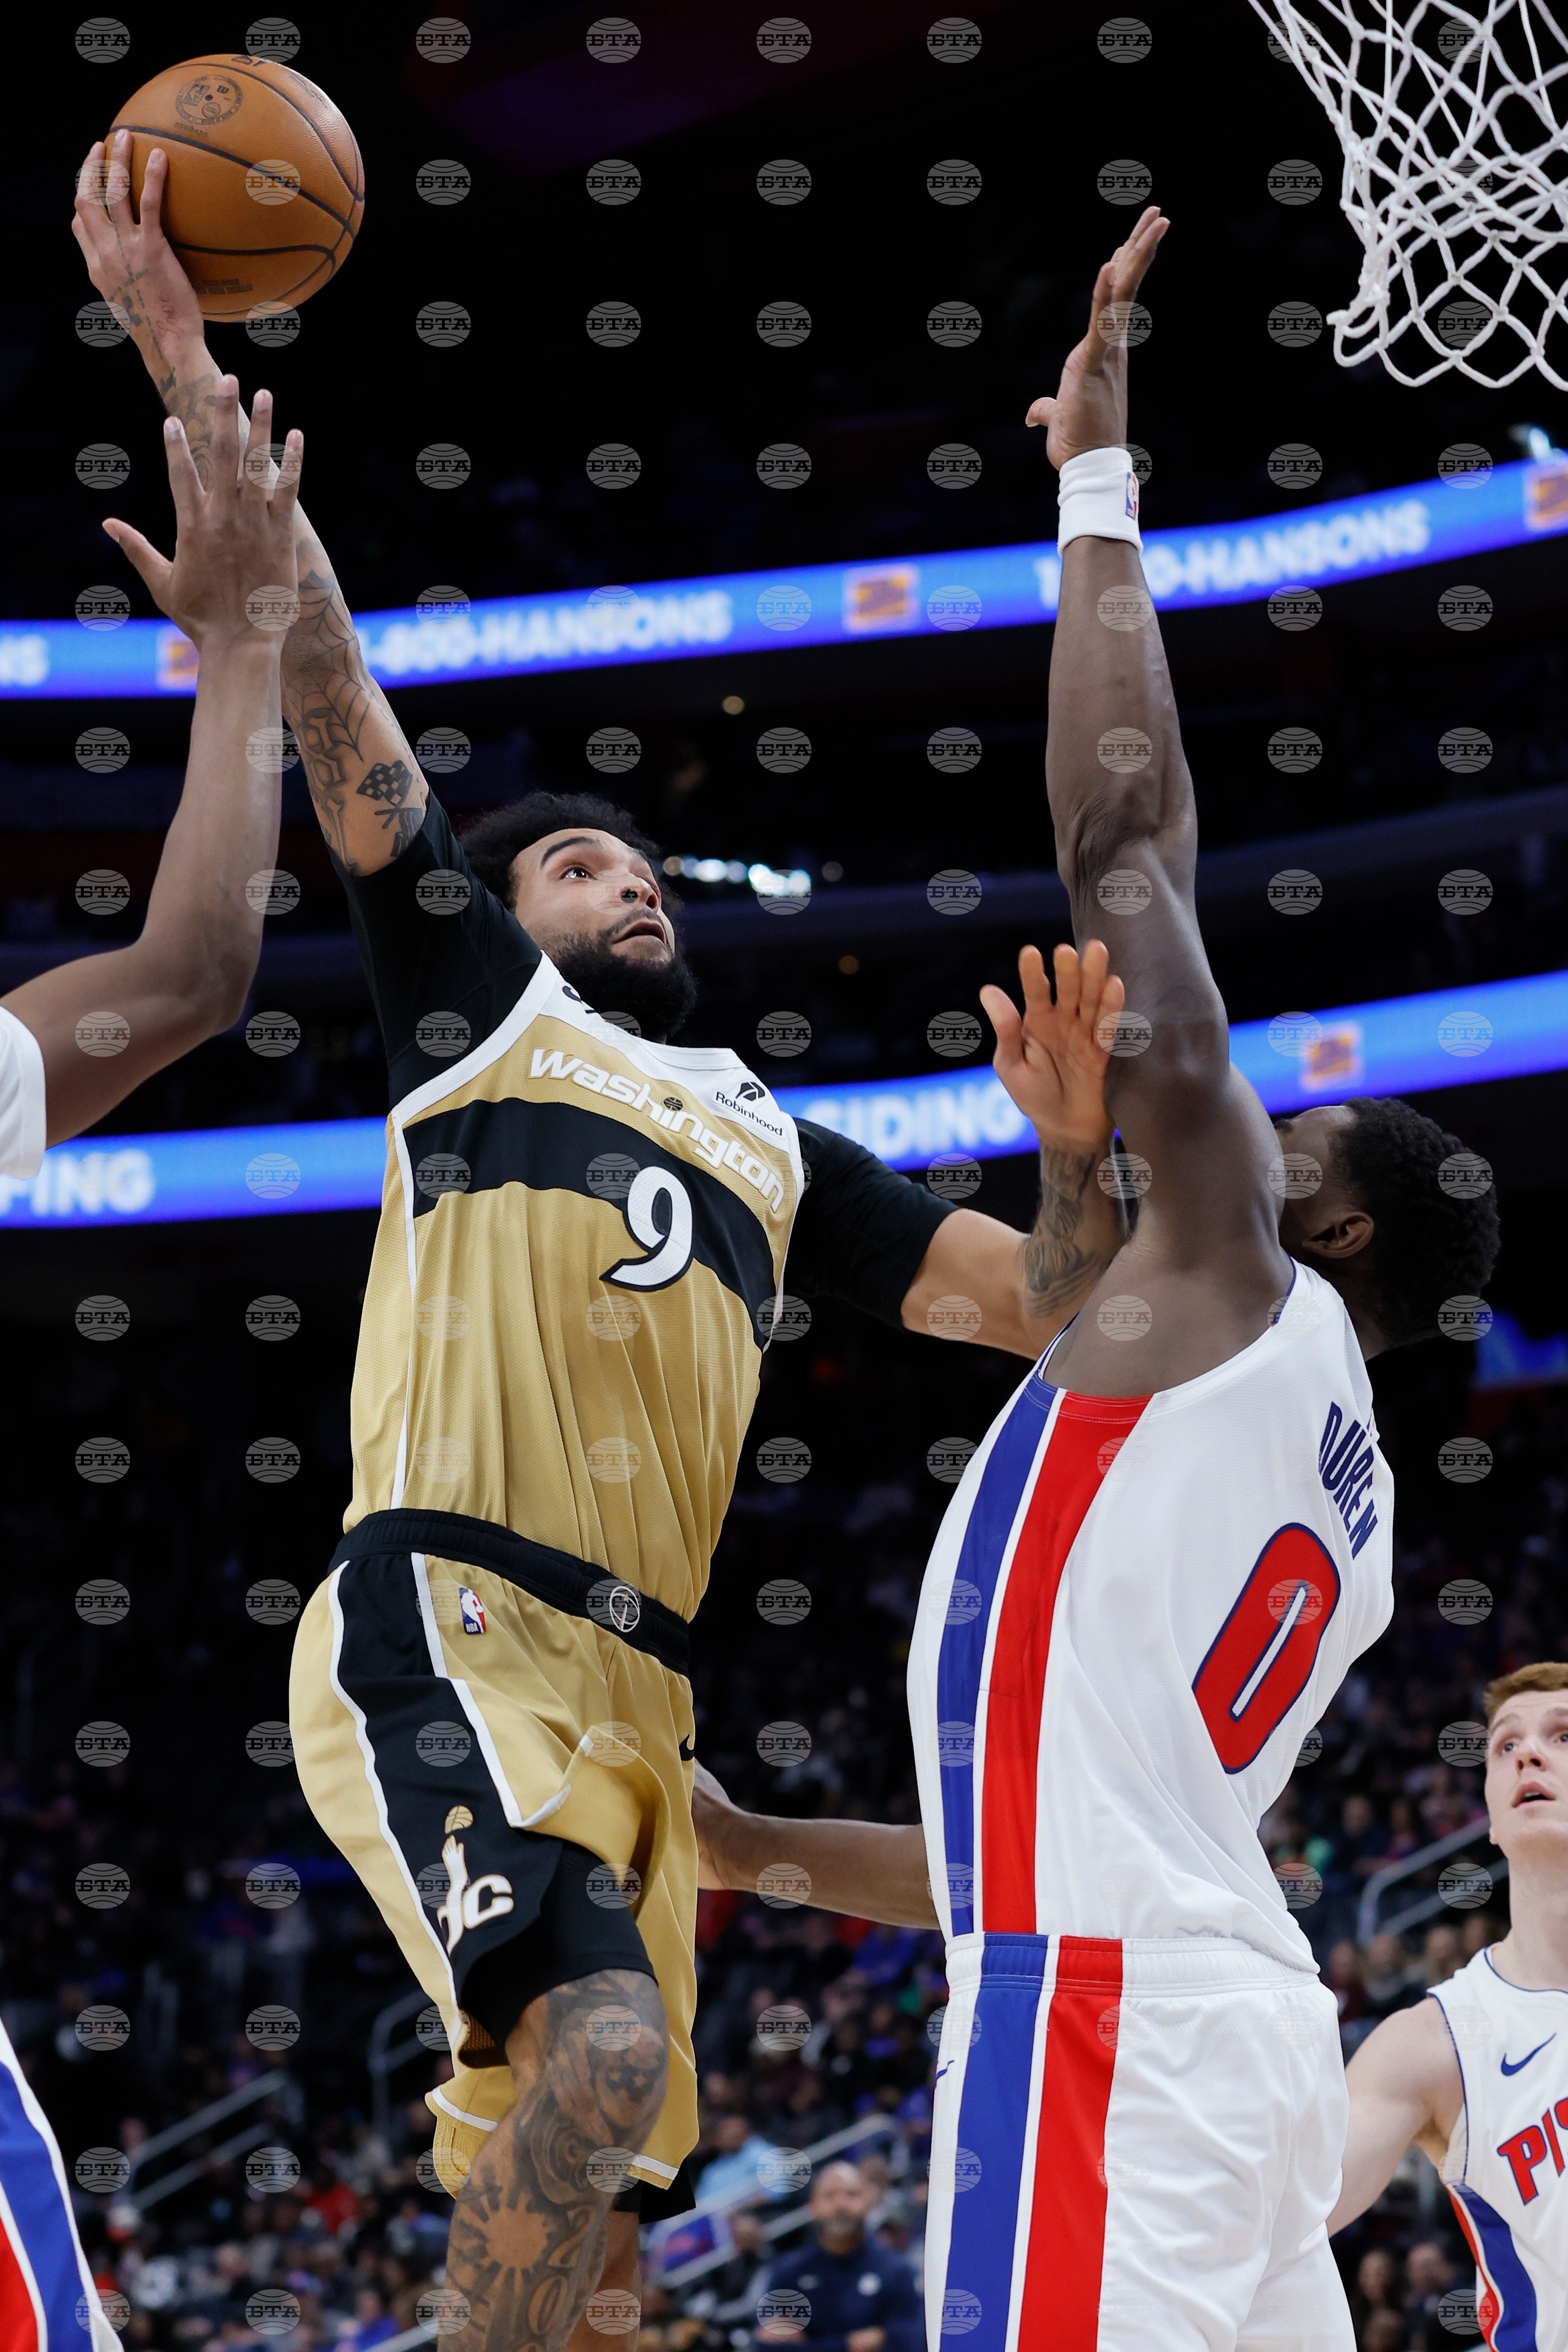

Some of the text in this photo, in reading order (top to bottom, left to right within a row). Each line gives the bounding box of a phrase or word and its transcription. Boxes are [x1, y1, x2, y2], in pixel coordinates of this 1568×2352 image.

[716, 1091, 783, 1136] Robinhood
[604, 1165, 693, 1290] 9
[1318, 1401, 1378, 1560] DUREN
[466, 1622, 479, 1633] NBA
[1191, 1522, 1341, 1775] 0
